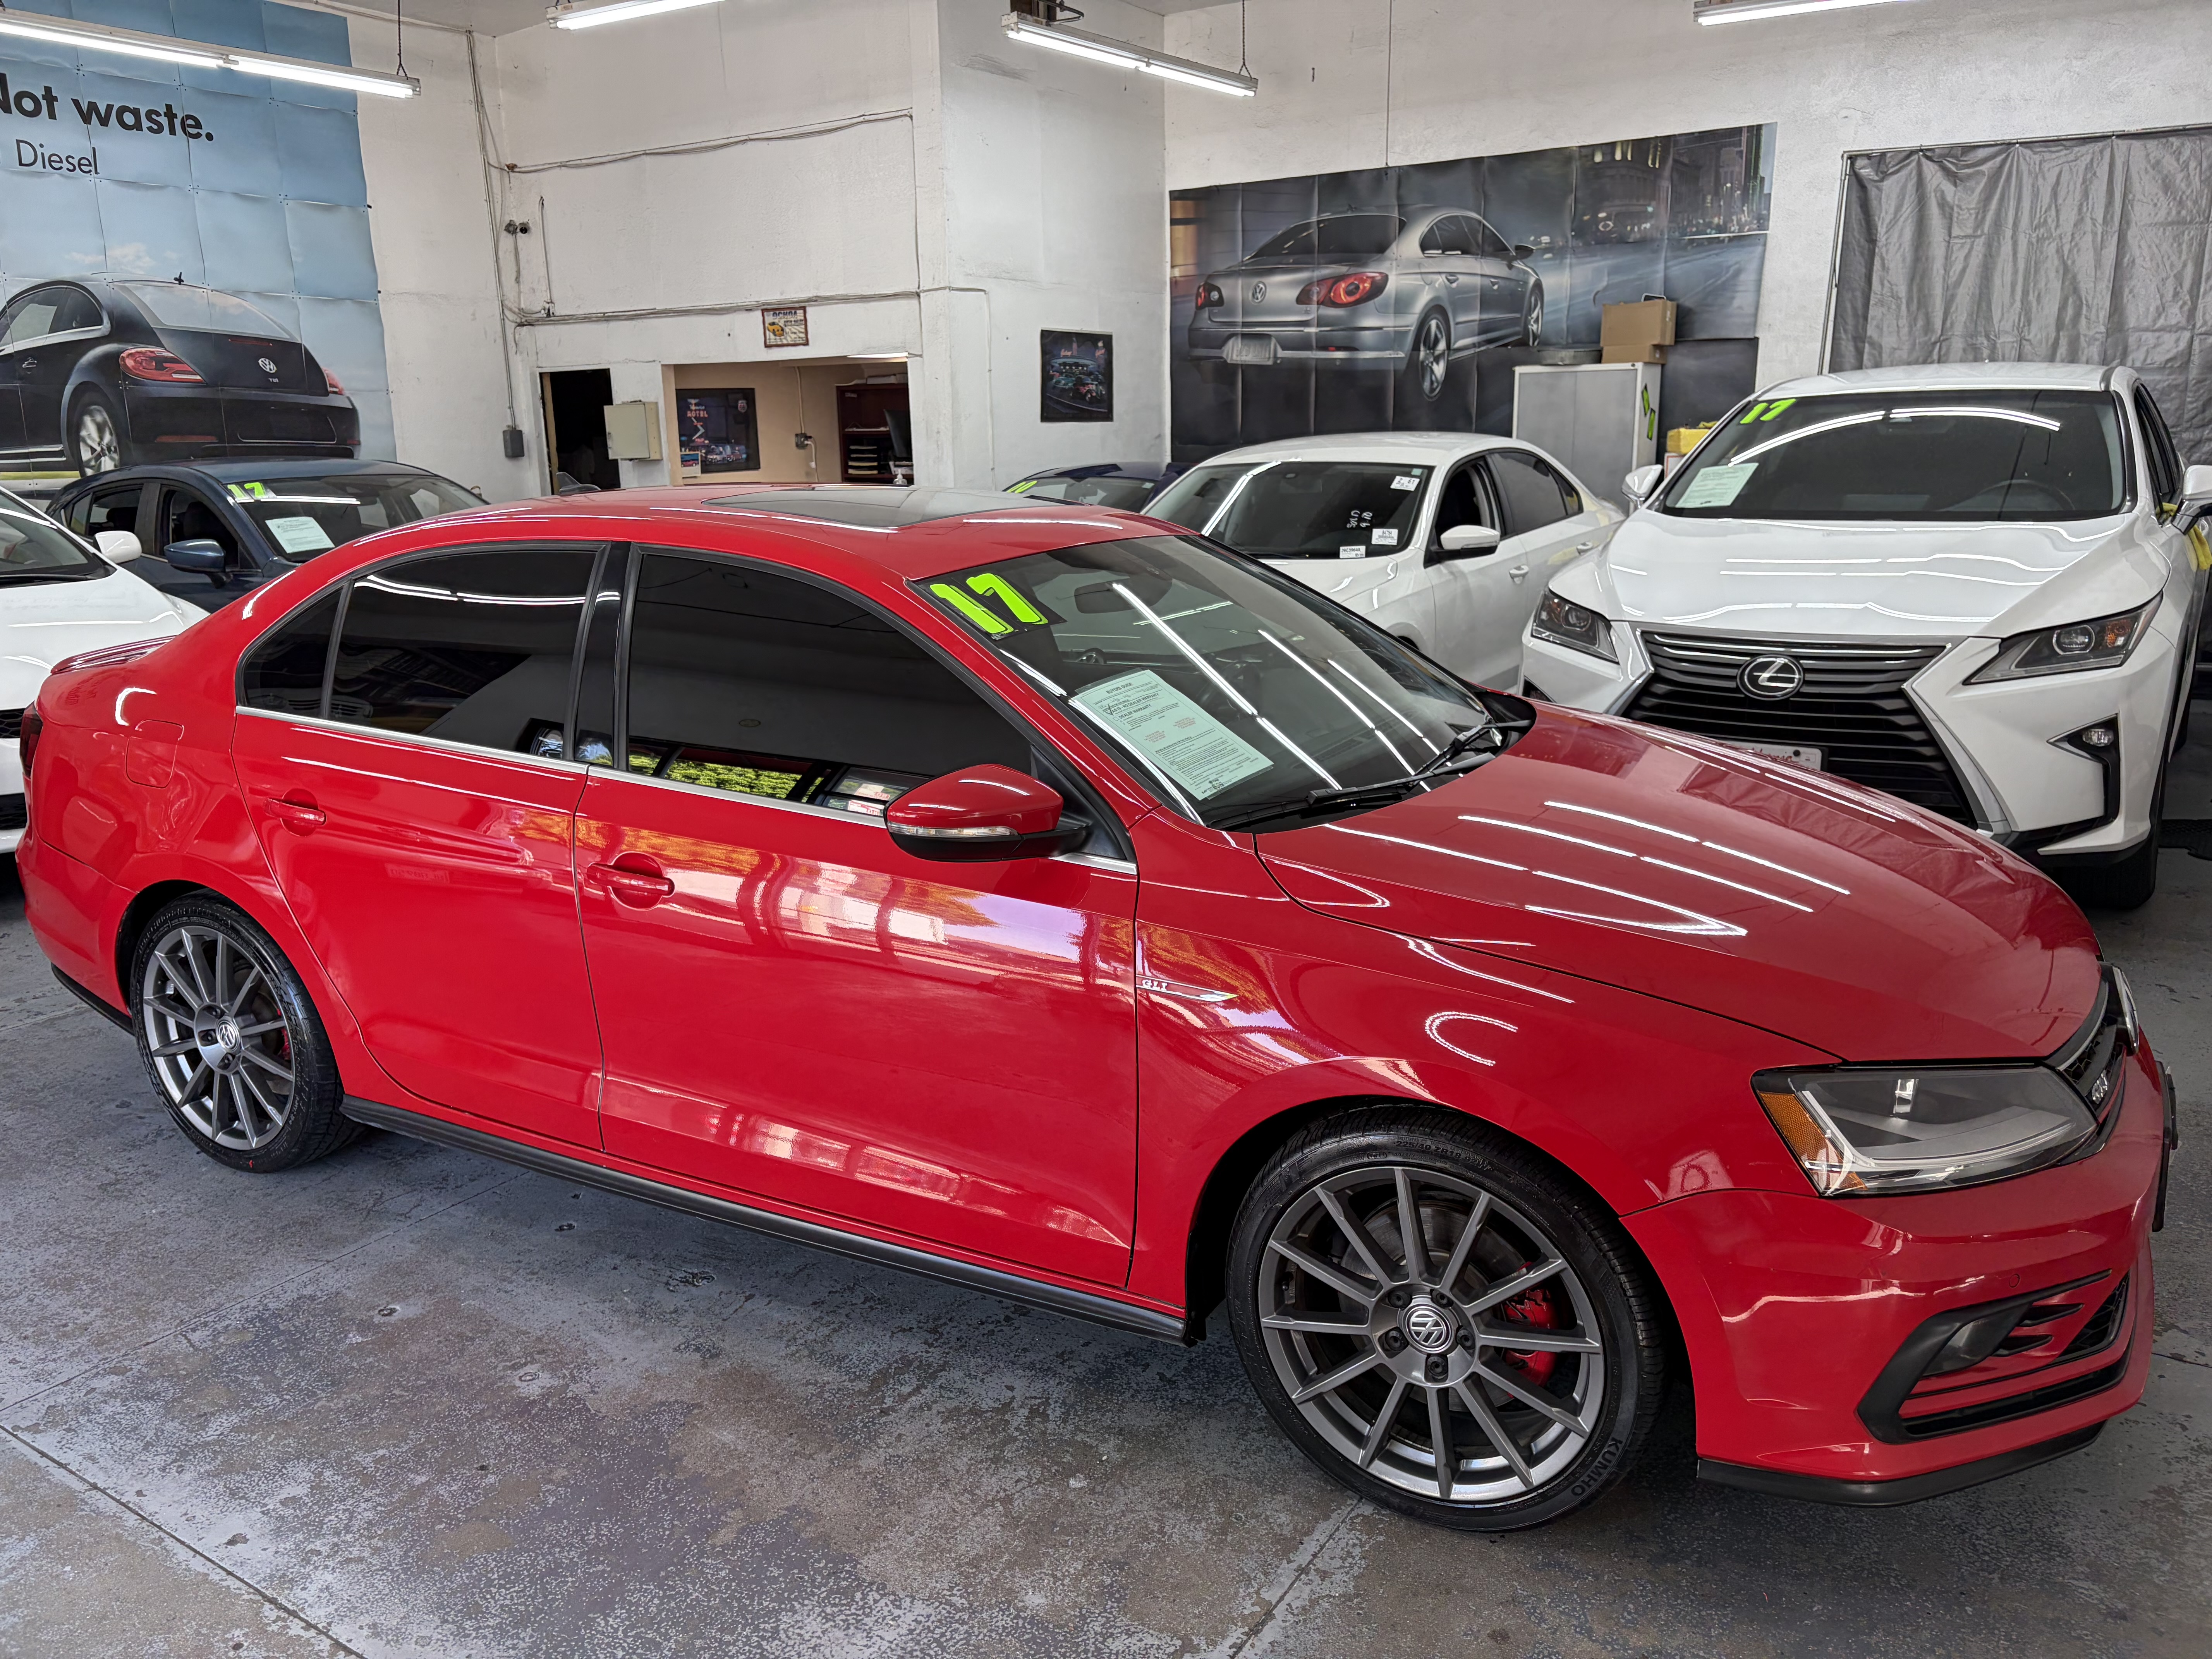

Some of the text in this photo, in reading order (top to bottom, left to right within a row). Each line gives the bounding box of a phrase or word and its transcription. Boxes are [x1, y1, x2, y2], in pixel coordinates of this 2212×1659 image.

[71, 98, 213, 141] waste.
[16, 139, 98, 175] Diesel
[1740, 399, 1796, 424] 17
[227, 482, 266, 500] 17
[930, 573, 1049, 634] 17
[1142, 693, 1159, 701] WARRANTY
[1132, 704, 1152, 713] WARRANTY
[1142, 979, 1168, 991] GLI
[1396, 1141, 1431, 1151] 225/40
[1434, 1146, 1462, 1159] ZR18
[1571, 1437, 1623, 1496] KUMHO
